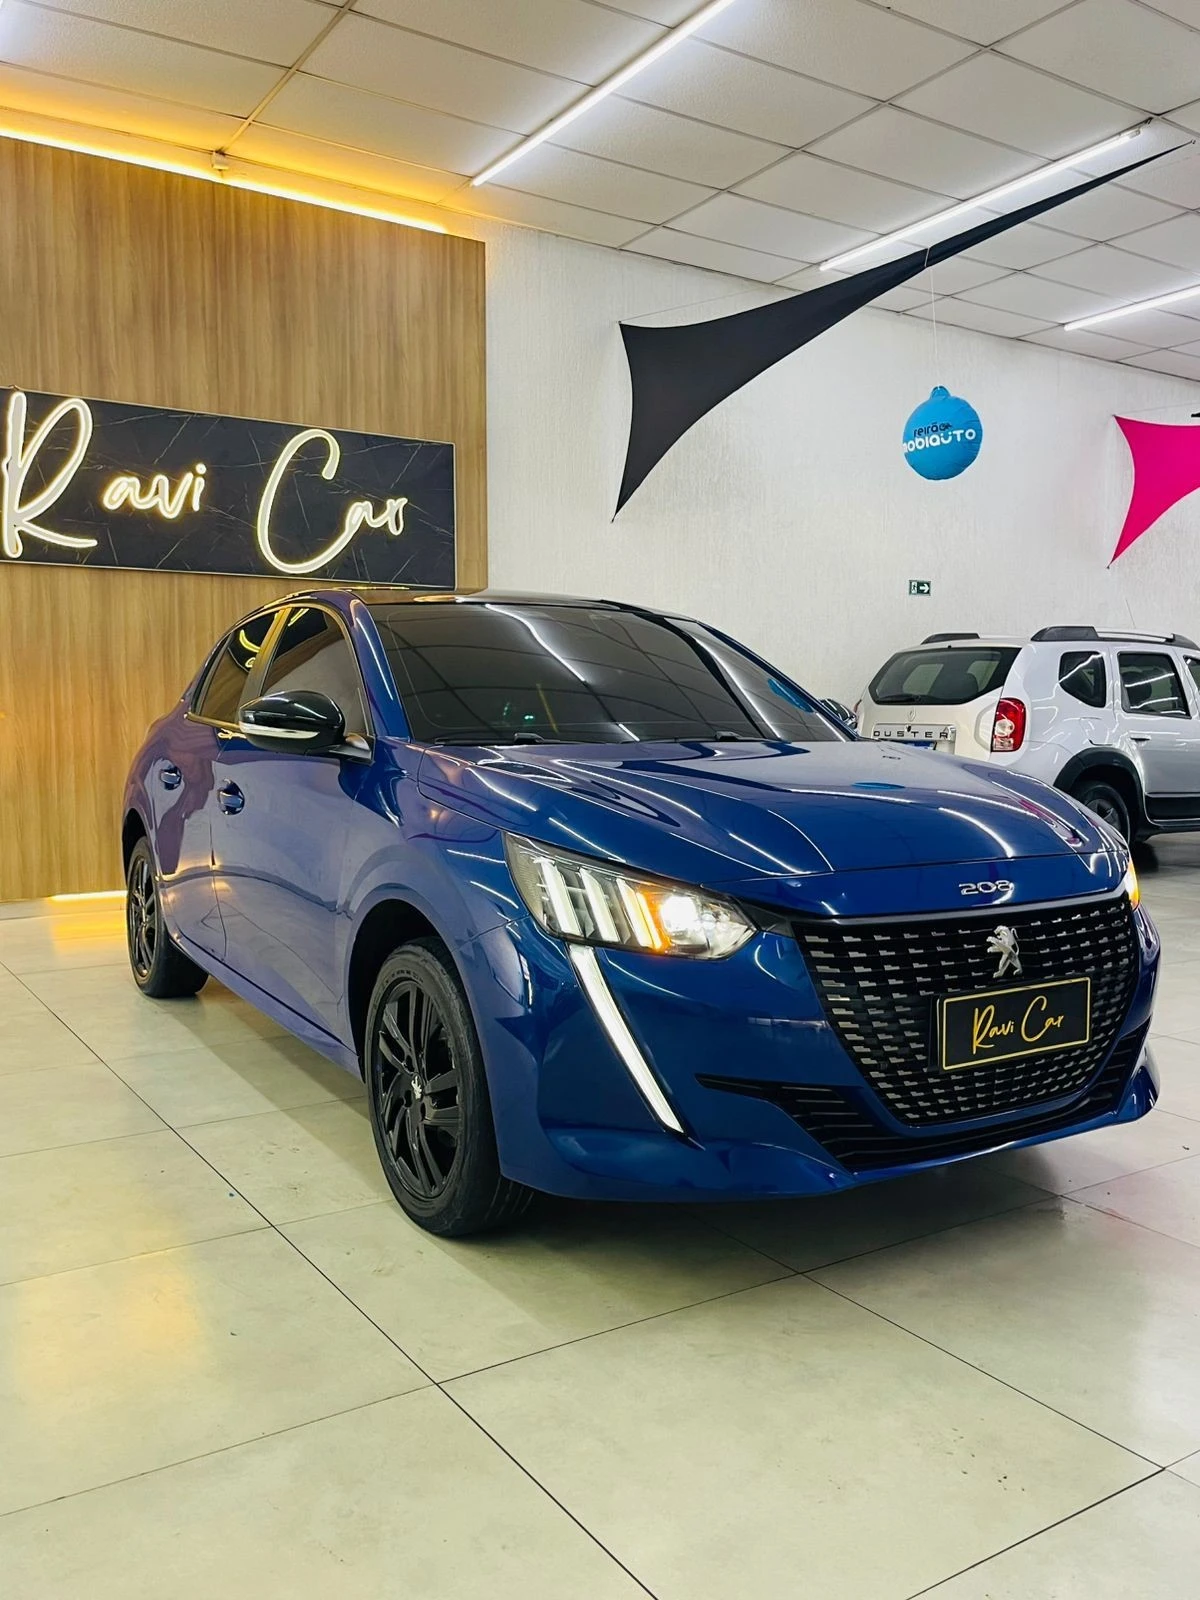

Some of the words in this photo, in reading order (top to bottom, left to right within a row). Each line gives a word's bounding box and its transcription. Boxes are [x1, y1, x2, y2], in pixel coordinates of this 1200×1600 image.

[2, 391, 206, 558] Ravi
[257, 429, 408, 574] Car
[873, 730, 949, 739] DUSTER
[959, 880, 1014, 896] 208
[972, 1004, 1014, 1055] Ravi
[1021, 995, 1064, 1042] Car
